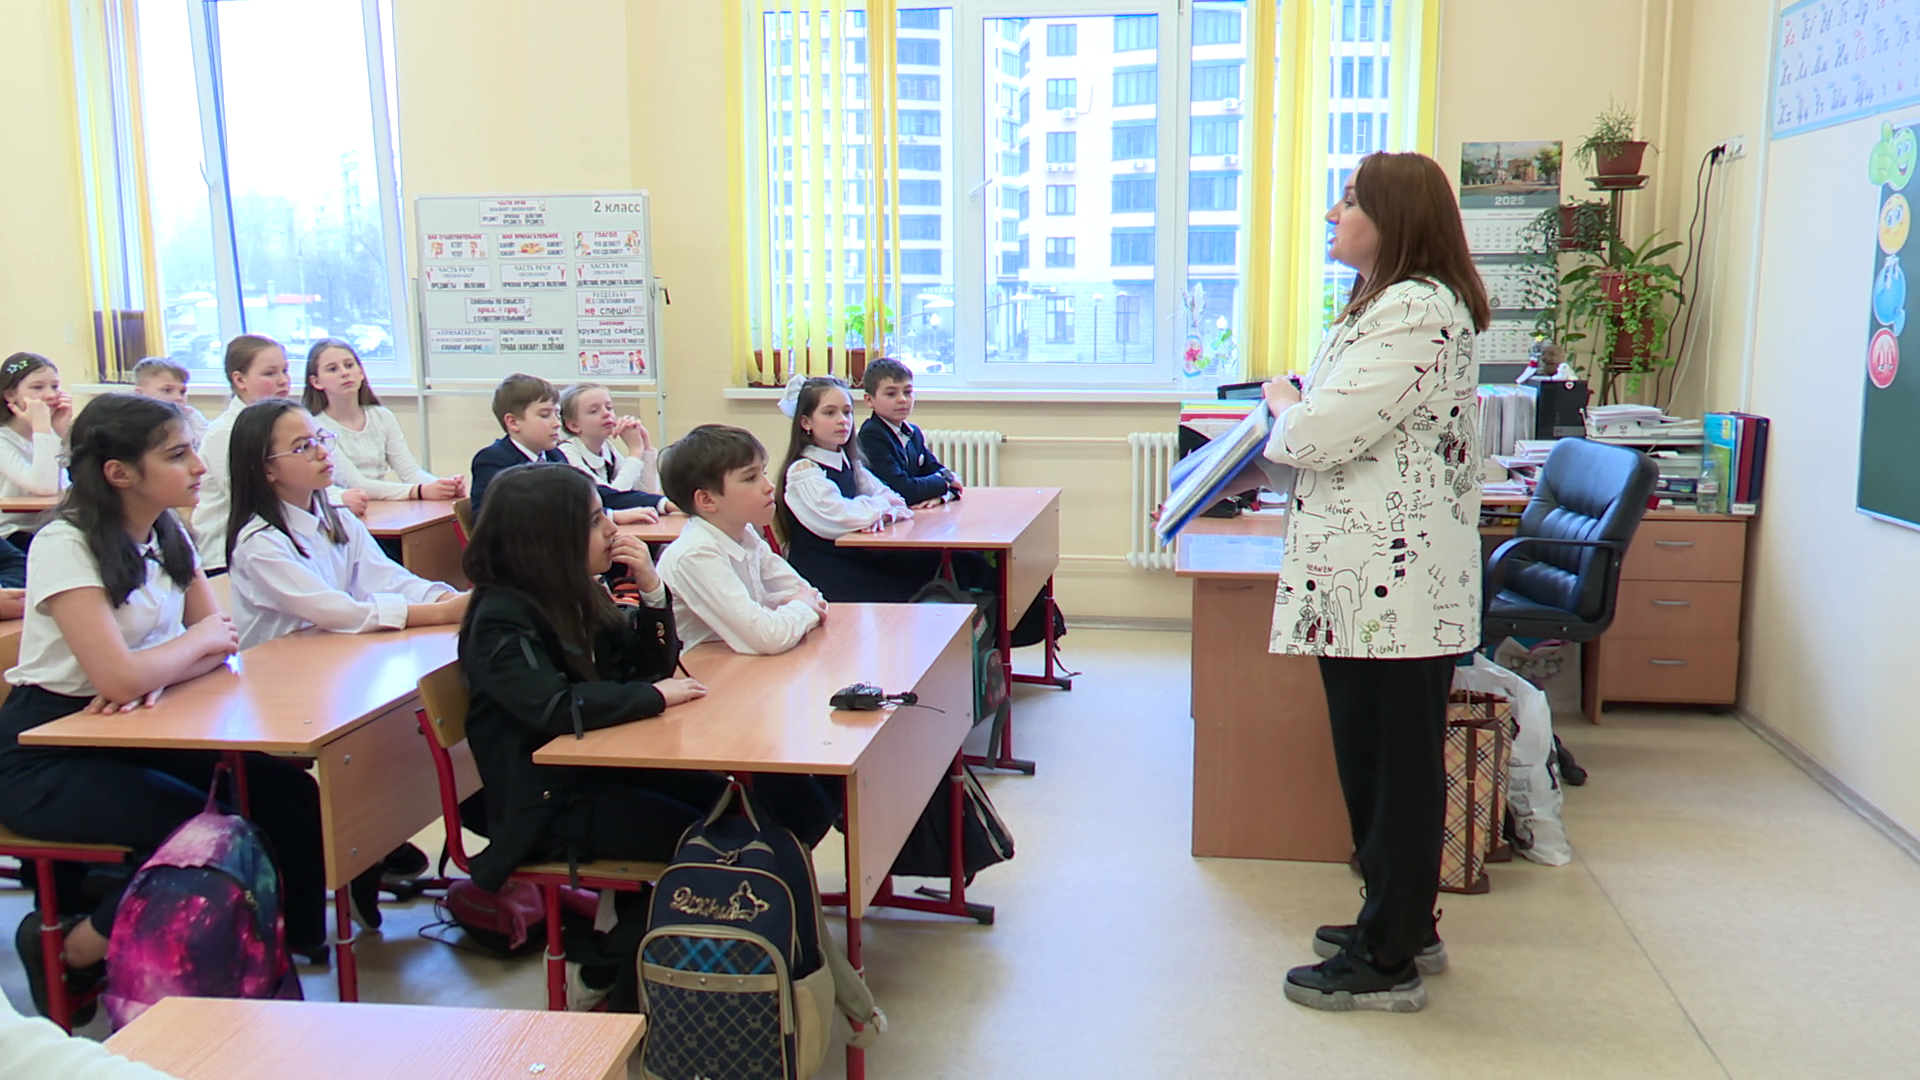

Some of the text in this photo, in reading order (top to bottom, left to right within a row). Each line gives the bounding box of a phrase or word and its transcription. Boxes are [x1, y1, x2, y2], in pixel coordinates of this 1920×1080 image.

[1494, 196, 1525, 206] 2025
[593, 200, 641, 213] 2 класс
[600, 306, 632, 315] спеши!
